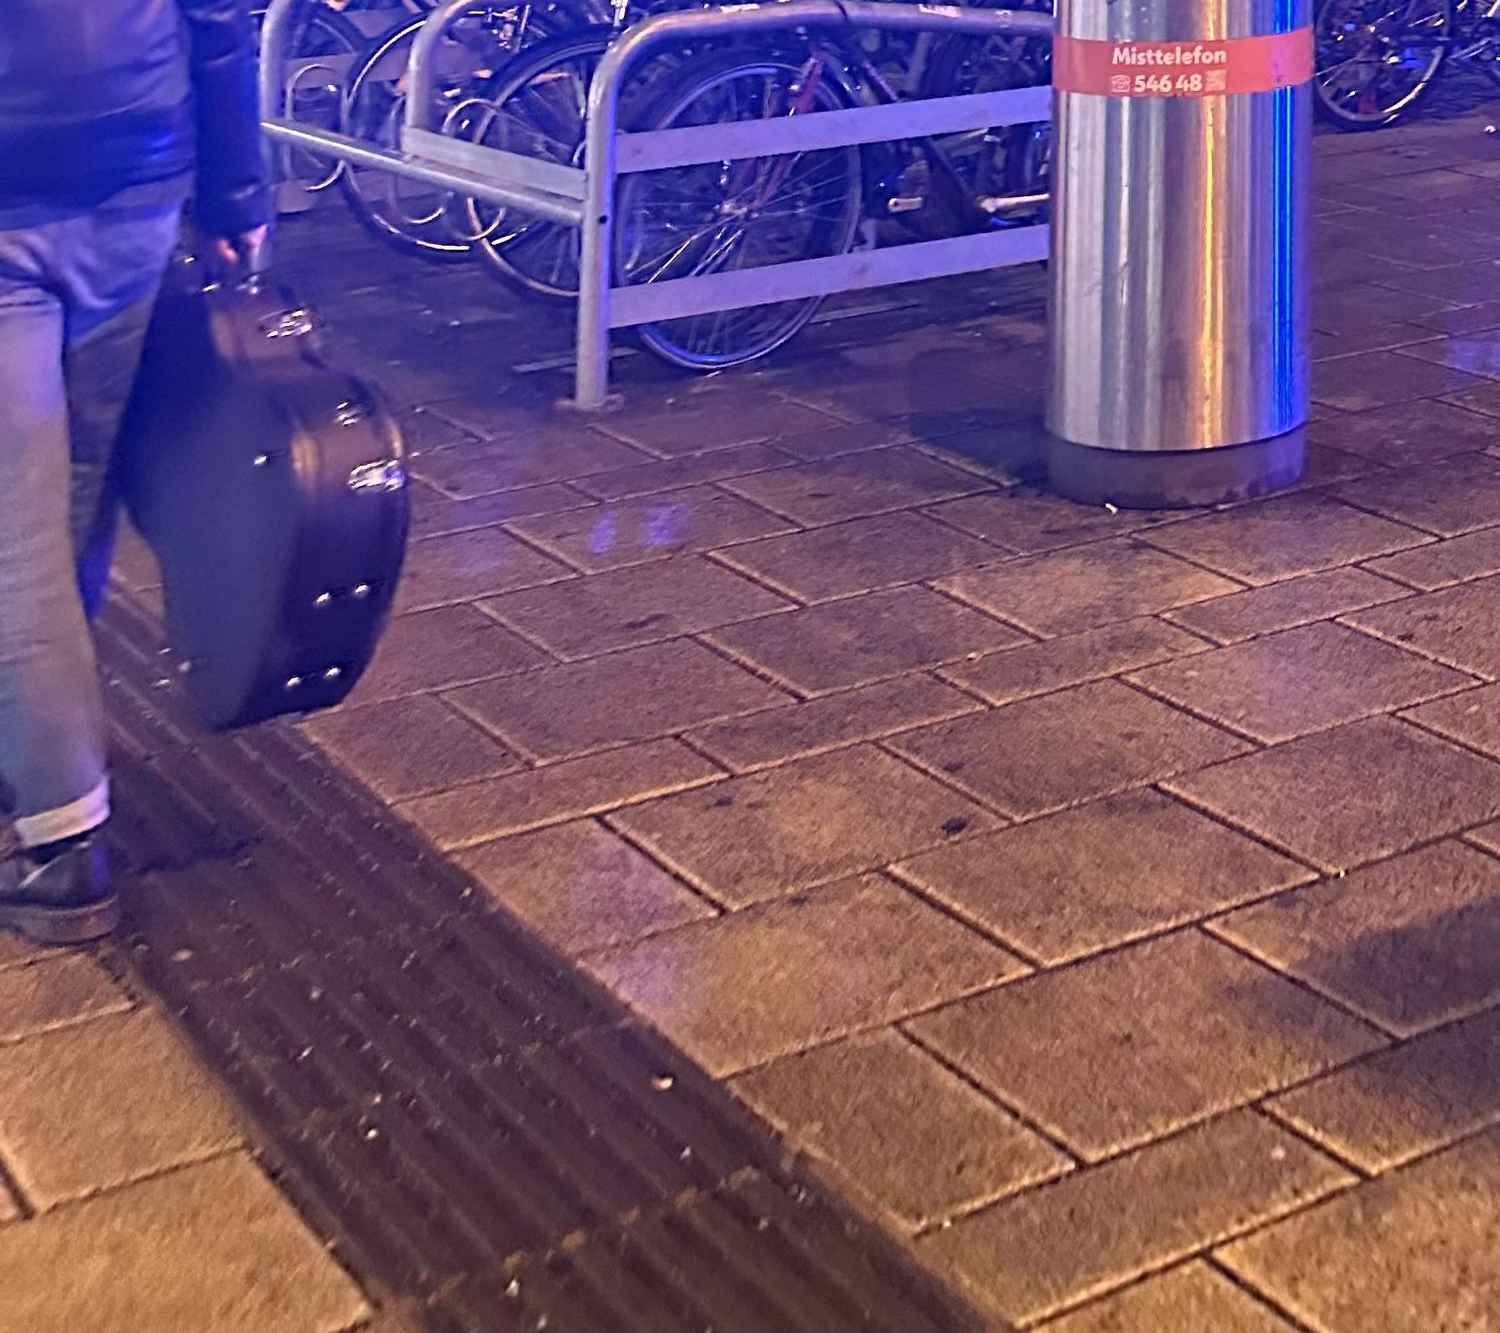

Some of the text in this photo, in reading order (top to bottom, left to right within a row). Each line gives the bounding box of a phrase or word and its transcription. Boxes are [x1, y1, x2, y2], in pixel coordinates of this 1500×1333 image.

[1112, 45, 1227, 65] Misttelefon
[1134, 74, 1203, 92] 546 48
